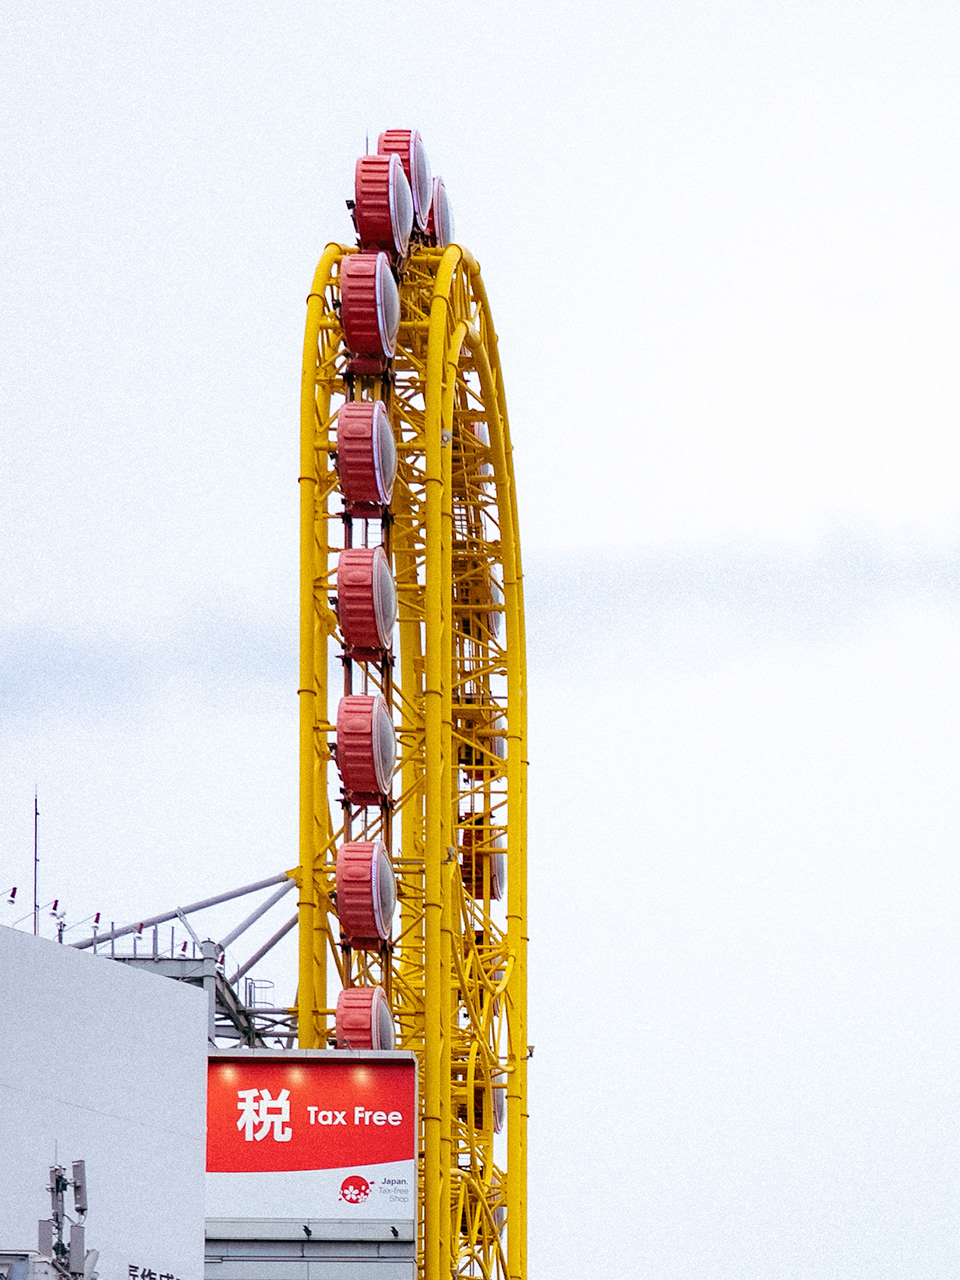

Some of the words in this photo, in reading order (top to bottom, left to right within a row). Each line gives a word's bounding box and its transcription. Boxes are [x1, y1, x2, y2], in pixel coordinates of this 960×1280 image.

[237, 1088, 293, 1142] 税
[307, 1106, 347, 1125] Tax
[354, 1107, 402, 1126] Free
[381, 1177, 409, 1189] Japan.
[378, 1187, 409, 1195] Tax-free
[388, 1195, 409, 1204] Shop
